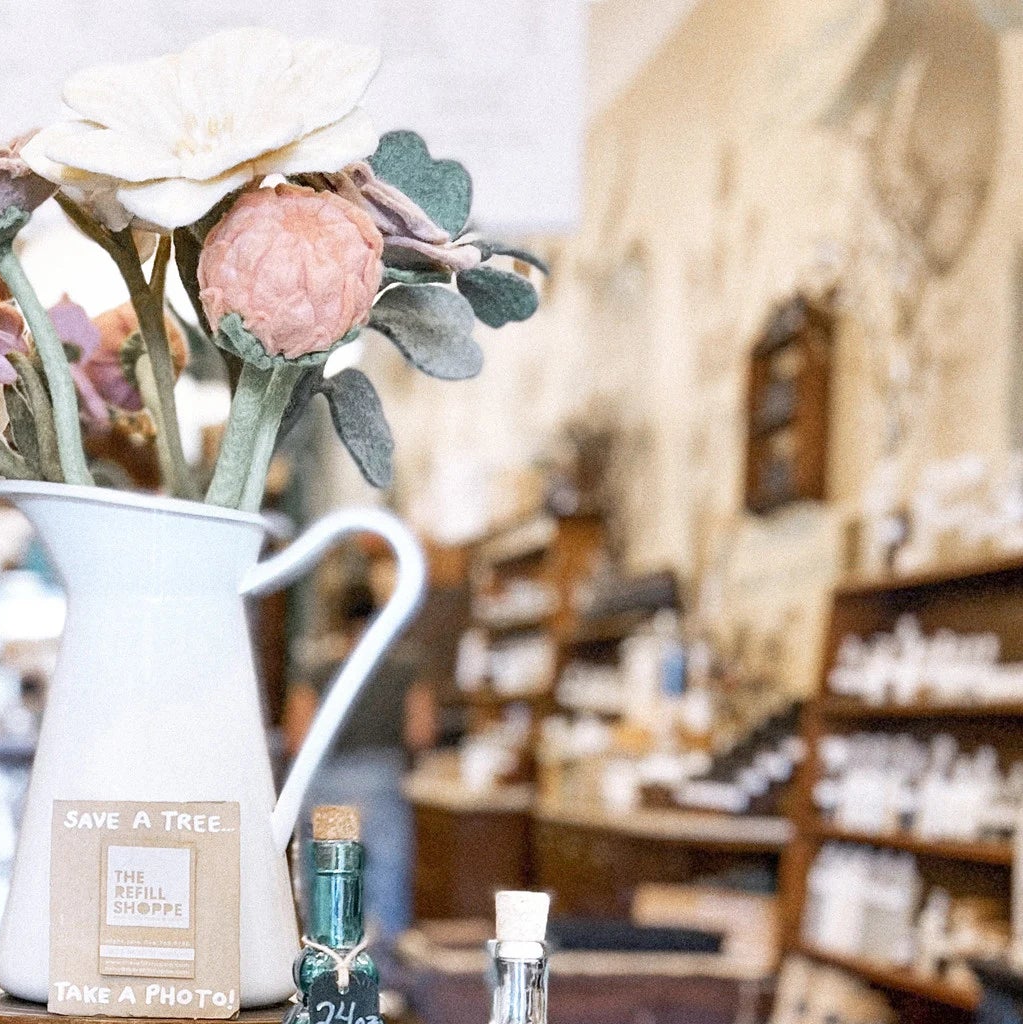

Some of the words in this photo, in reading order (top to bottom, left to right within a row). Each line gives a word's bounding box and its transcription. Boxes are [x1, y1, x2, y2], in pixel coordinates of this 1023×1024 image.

[63, 810, 120, 830] SAVE
[132, 810, 152, 830] A
[114, 870, 145, 884] THE
[114, 886, 166, 900] REFILL
[113, 901, 182, 916] SHOPPE
[53, 981, 112, 1005] TAKE
[118, 986, 136, 1005] A
[145, 984, 235, 1009] PHOTO!
